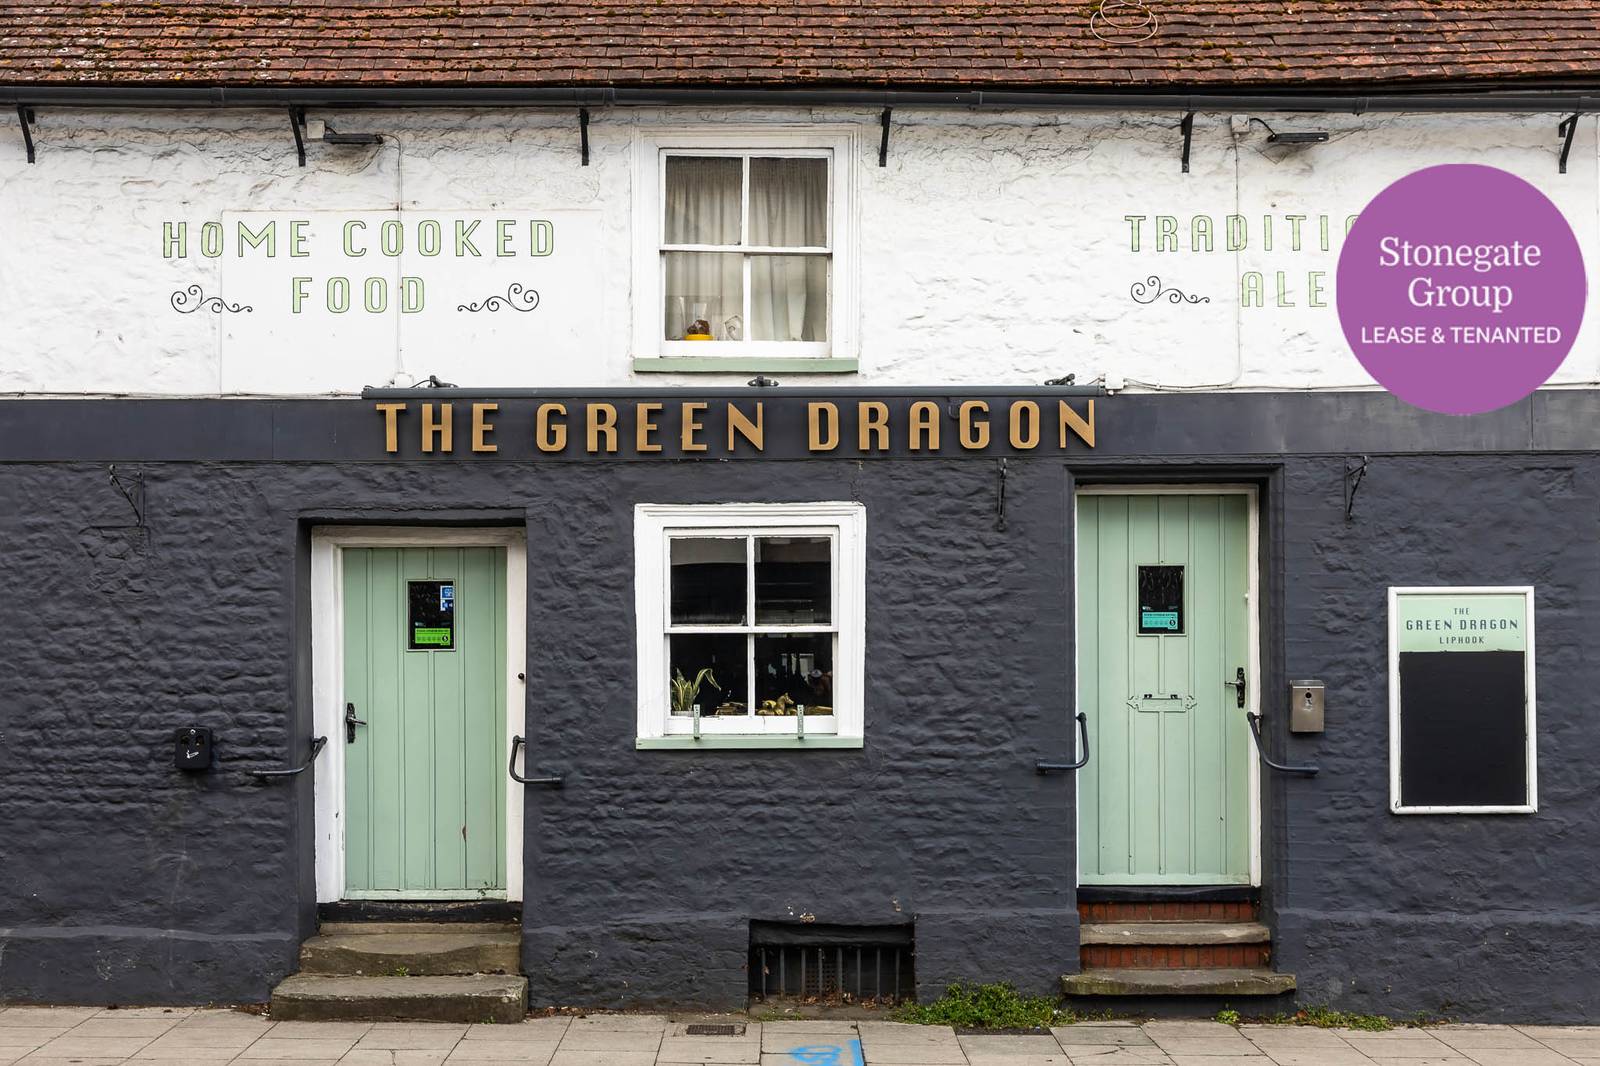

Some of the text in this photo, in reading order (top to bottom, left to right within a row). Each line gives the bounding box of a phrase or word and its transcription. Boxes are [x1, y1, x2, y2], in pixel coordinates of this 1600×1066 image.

[162, 219, 555, 258] HOME COOKED
[1124, 214, 1361, 252] TRADITI
[291, 276, 426, 314] FOOD
[375, 398, 1097, 453] THE GREEN DRAGON
[1405, 618, 1519, 631] GREEN DRAGON
[1453, 607, 1470, 615] THE
[1439, 635, 1486, 645] LIPHOOK
